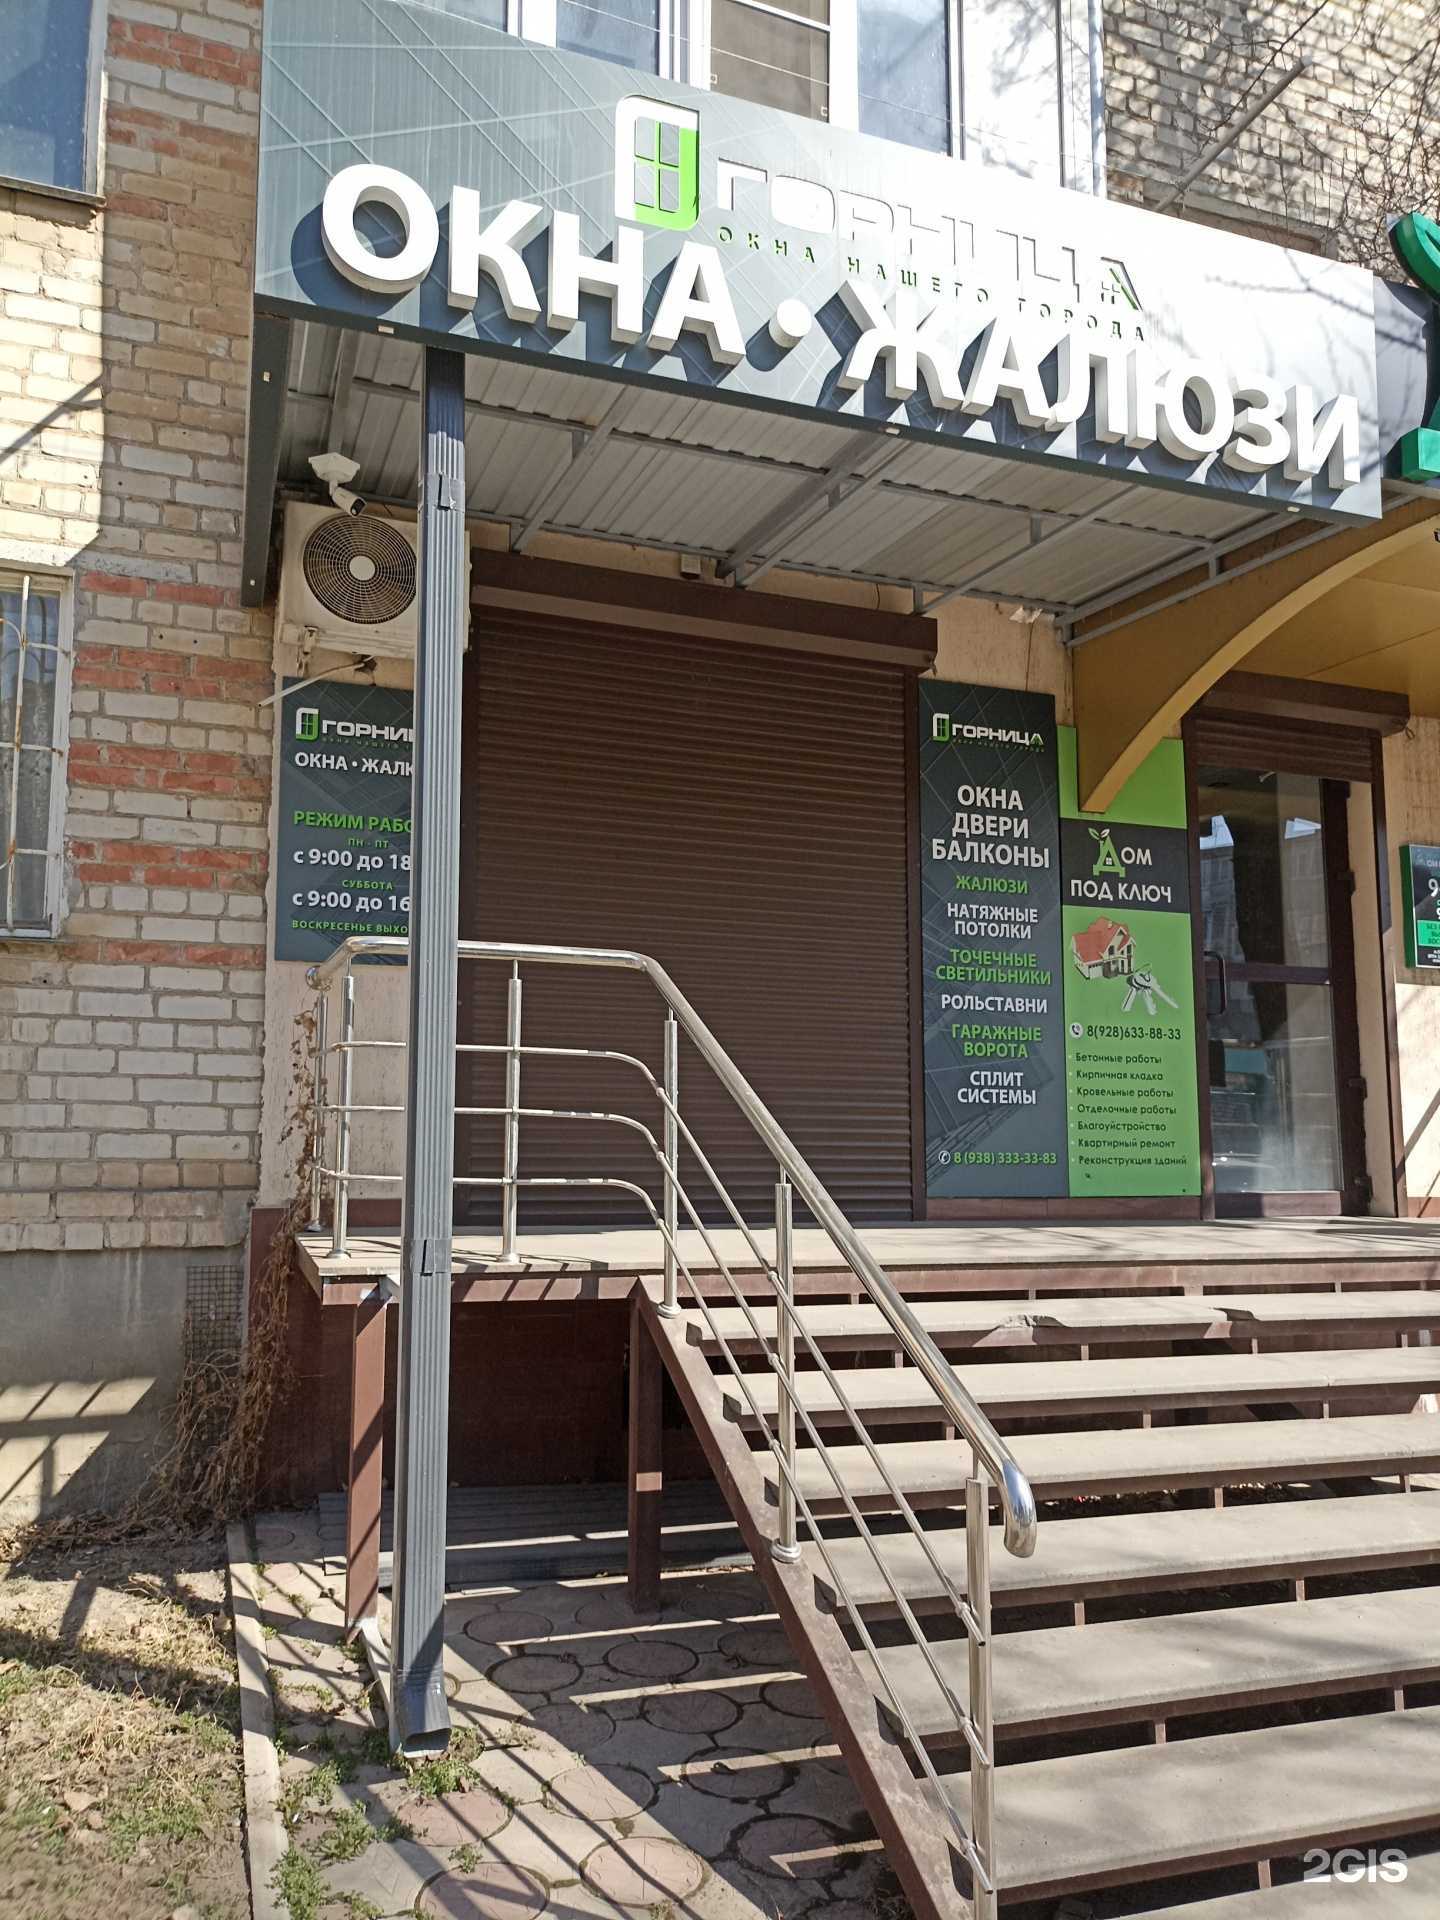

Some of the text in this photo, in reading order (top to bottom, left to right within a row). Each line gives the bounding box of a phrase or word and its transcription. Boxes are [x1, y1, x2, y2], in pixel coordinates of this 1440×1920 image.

[718, 225, 1146, 342] ОКНА НАШЕГО ГОРОДА
[321, 163, 747, 367] ОКНА
[835, 278, 1361, 489] ЖАЛЮЗИ
[951, 723, 1045, 746] ГОРНИЦА
[294, 751, 349, 771] ОКНА
[957, 784, 1024, 811] ОКНА
[293, 810, 364, 830] РЕЖИМ
[952, 812, 1029, 839] ДВЕРИ
[375, 839, 390, 849] ПТ
[932, 838, 1050, 869] БАЛКОНЫ
[293, 851, 304, 865] с
[308, 848, 352, 867] 9:00
[356, 854, 384, 872] до
[342, 879, 393, 891] СУББОТА
[956, 874, 1028, 894] ЖАЛЮЗИ
[1070, 879, 1172, 904] ПОД КЛЮЧ
[292, 892, 303, 906] с
[307, 890, 351, 908] 9:00
[355, 896, 383, 913] до
[947, 902, 1038, 923] НАТЯЖНЫЕ
[292, 919, 373, 933] ВОСКРЕСЕНЬЕ
[954, 920, 1032, 940] ПОТОЛКИ
[950, 948, 1037, 968] ТОЧЕЧНЫЕ
[935, 965, 1051, 985] СВЕТИЛЬНИКИ
[941, 994, 1048, 1014] РОЛЬСТАВНИ
[951, 1023, 1042, 1041] ГАРАЖНЫЕ
[1087, 1025, 1182, 1040] 8(928)633-88-33
[963, 1041, 1029, 1058] ВОРОТА
[1075, 1052, 1162, 1065] Бетонные работы
[970, 1070, 1024, 1087] СПЛИТ
[1076, 1069, 1164, 1081] Кирпичная кладка
[957, 1087, 1037, 1105] СИСТЕМЫ
[1076, 1086, 1174, 1099] Кровельные работы
[1077, 1103, 1177, 1116] Отделочные работы
[1078, 1138, 1176, 1150] Квартирный ремонт
[998, 1152, 1057, 1165] 333-33-83
[1078, 1155, 1187, 1168] Реконструкция зданий
